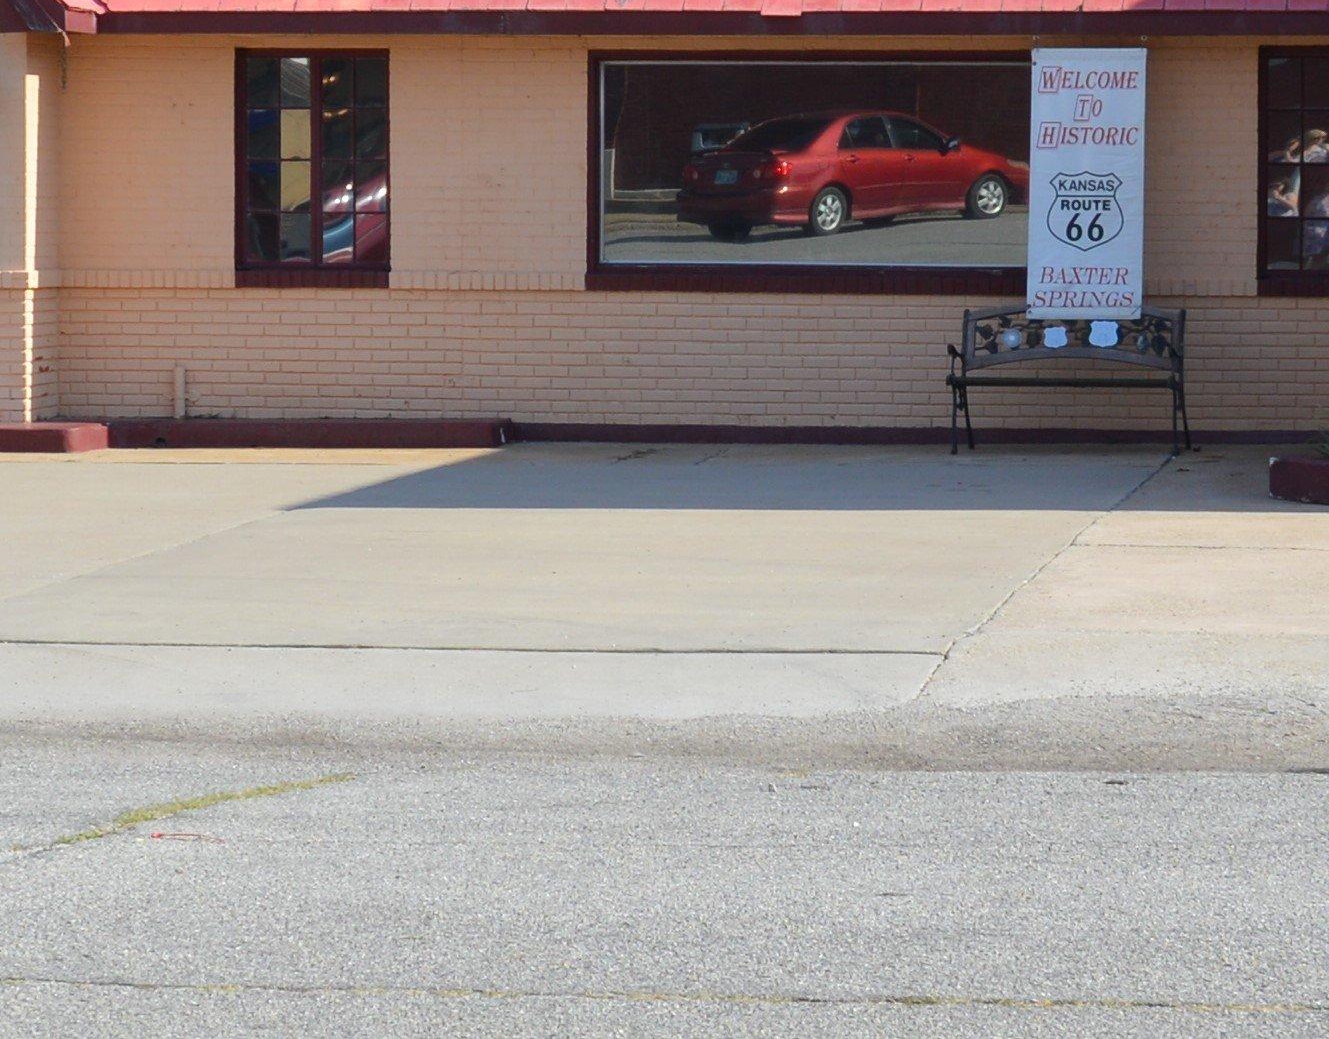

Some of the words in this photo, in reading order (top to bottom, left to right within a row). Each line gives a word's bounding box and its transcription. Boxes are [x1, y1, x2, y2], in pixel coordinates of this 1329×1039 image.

[1042, 68, 1139, 89] WELCOME
[1078, 98, 1103, 117] TO
[1042, 126, 1139, 146] HISTORIC
[1058, 180, 1115, 191] KANSAS
[1060, 199, 1111, 211] ROUTE
[1065, 212, 1104, 242] 66
[1039, 266, 1129, 285] BAXTER
[1032, 290, 1134, 308] SPRINGS
